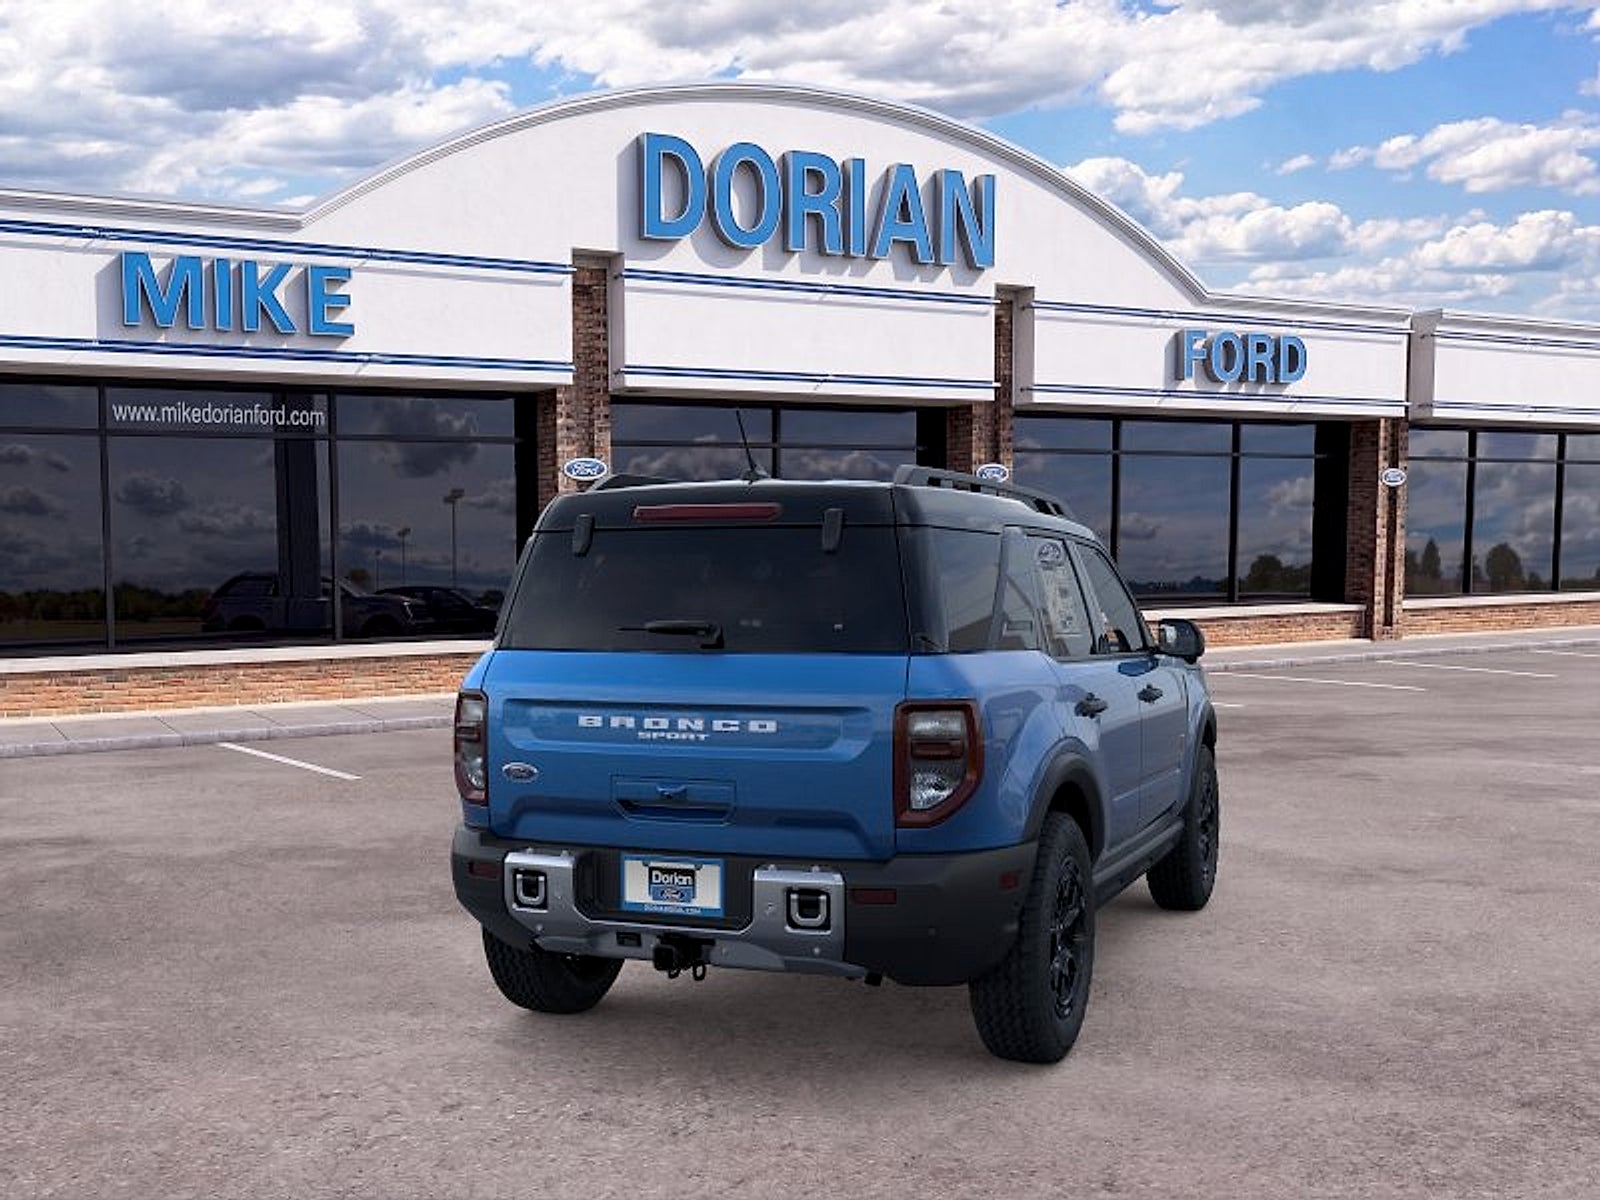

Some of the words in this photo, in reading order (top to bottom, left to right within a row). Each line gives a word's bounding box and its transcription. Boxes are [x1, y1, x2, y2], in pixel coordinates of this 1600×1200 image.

[638, 132, 996, 270] DORIAN
[121, 252, 356, 337] MIKE
[1177, 330, 1308, 384] FORD
[112, 402, 325, 426] www.mikedorianford.com
[579, 715, 778, 733] BRONCO
[637, 731, 709, 741] SPORT
[651, 870, 693, 885] Dorian
